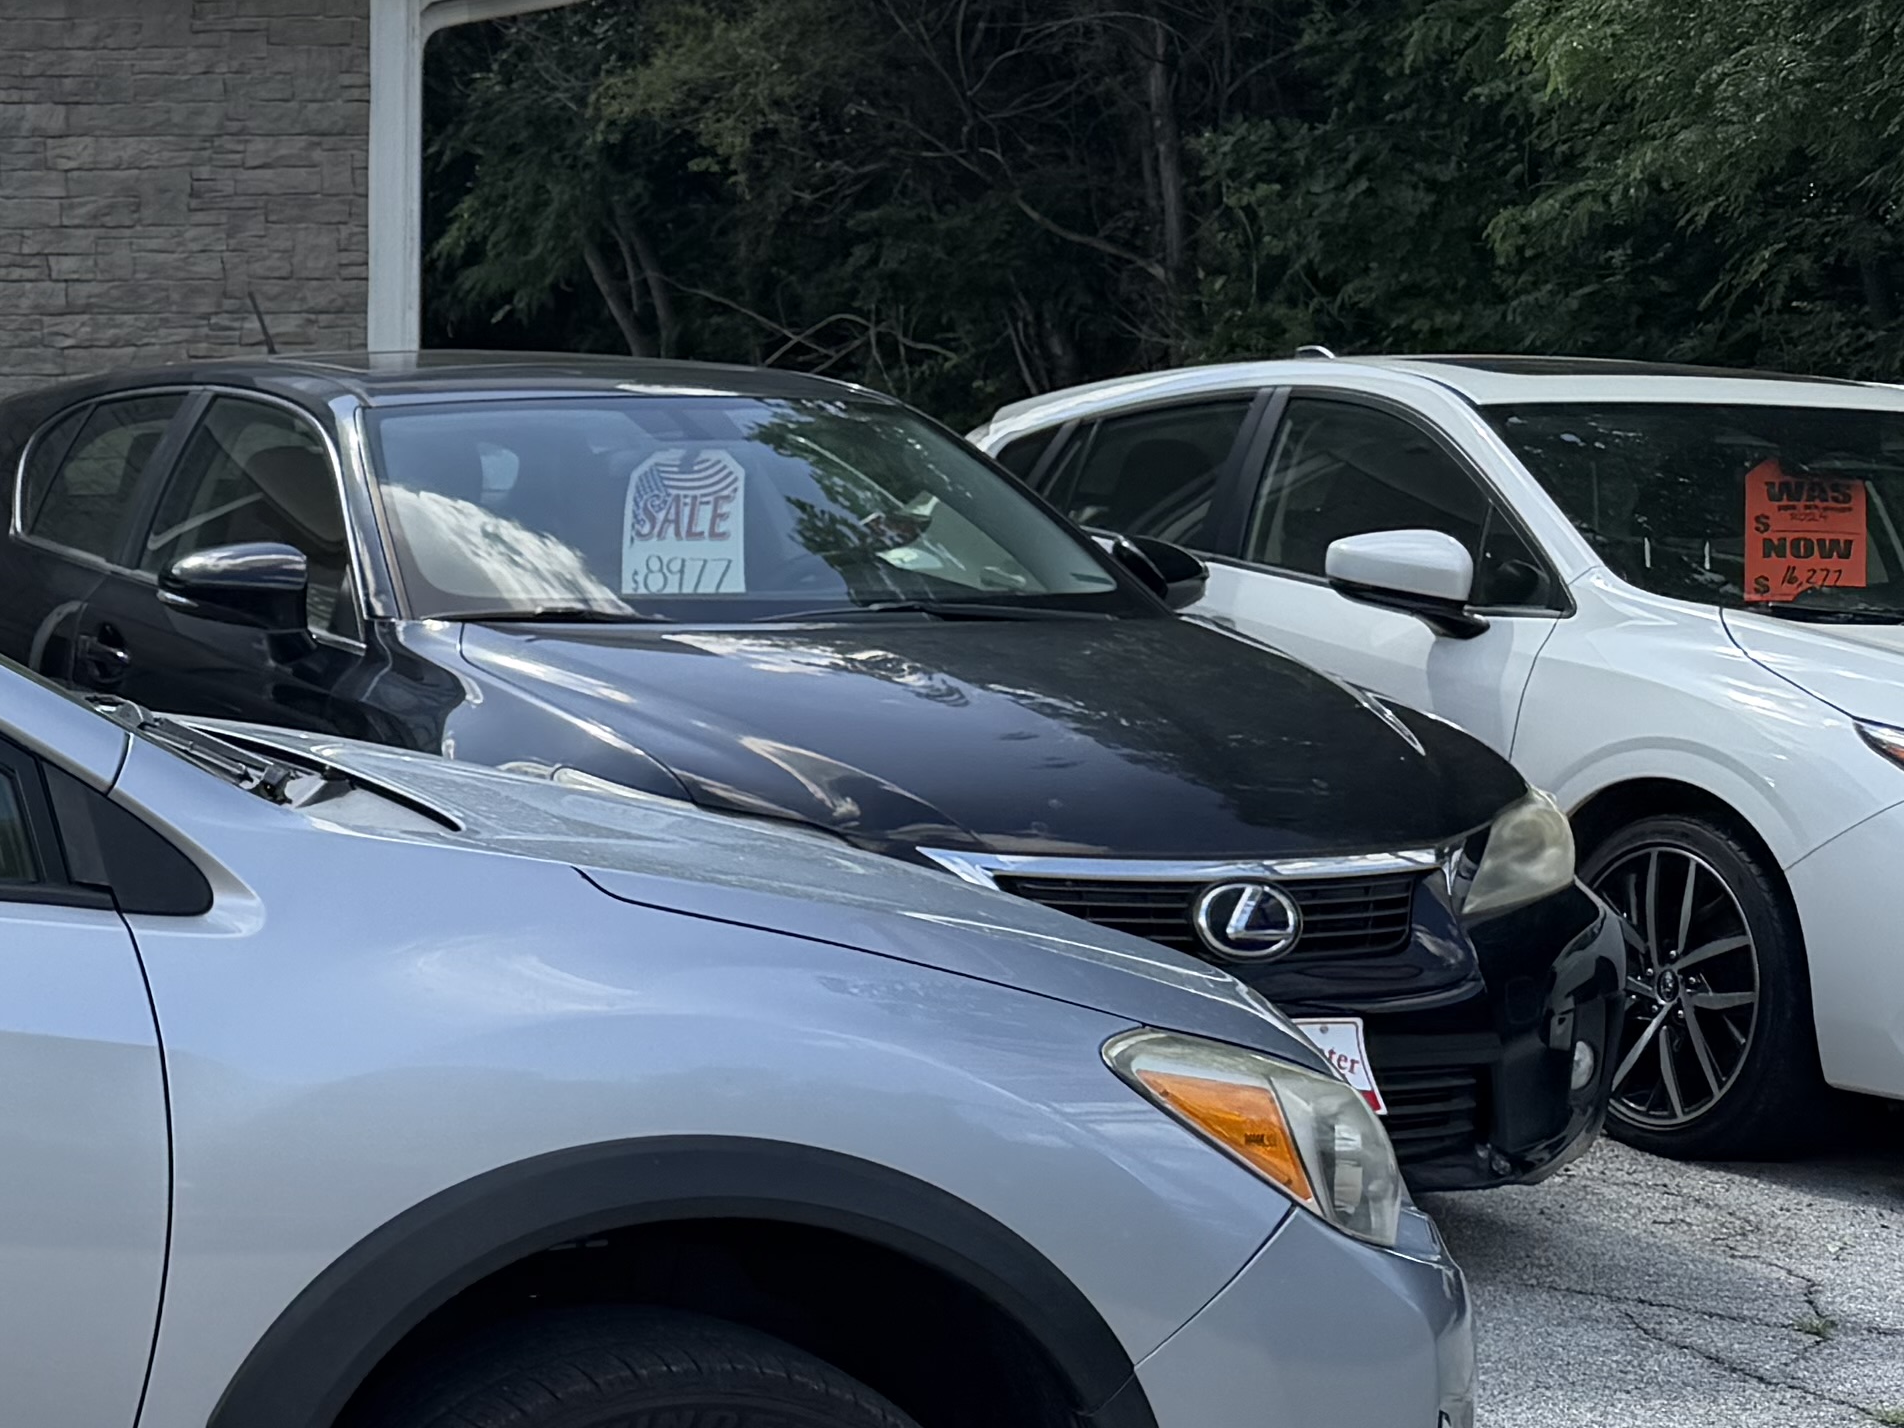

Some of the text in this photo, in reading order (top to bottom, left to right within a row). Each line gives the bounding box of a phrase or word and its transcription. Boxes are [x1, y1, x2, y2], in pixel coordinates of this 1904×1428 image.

[1765, 480, 1853, 504] WAS
[634, 491, 735, 542] SALE
[1762, 537, 1854, 560] NOW
